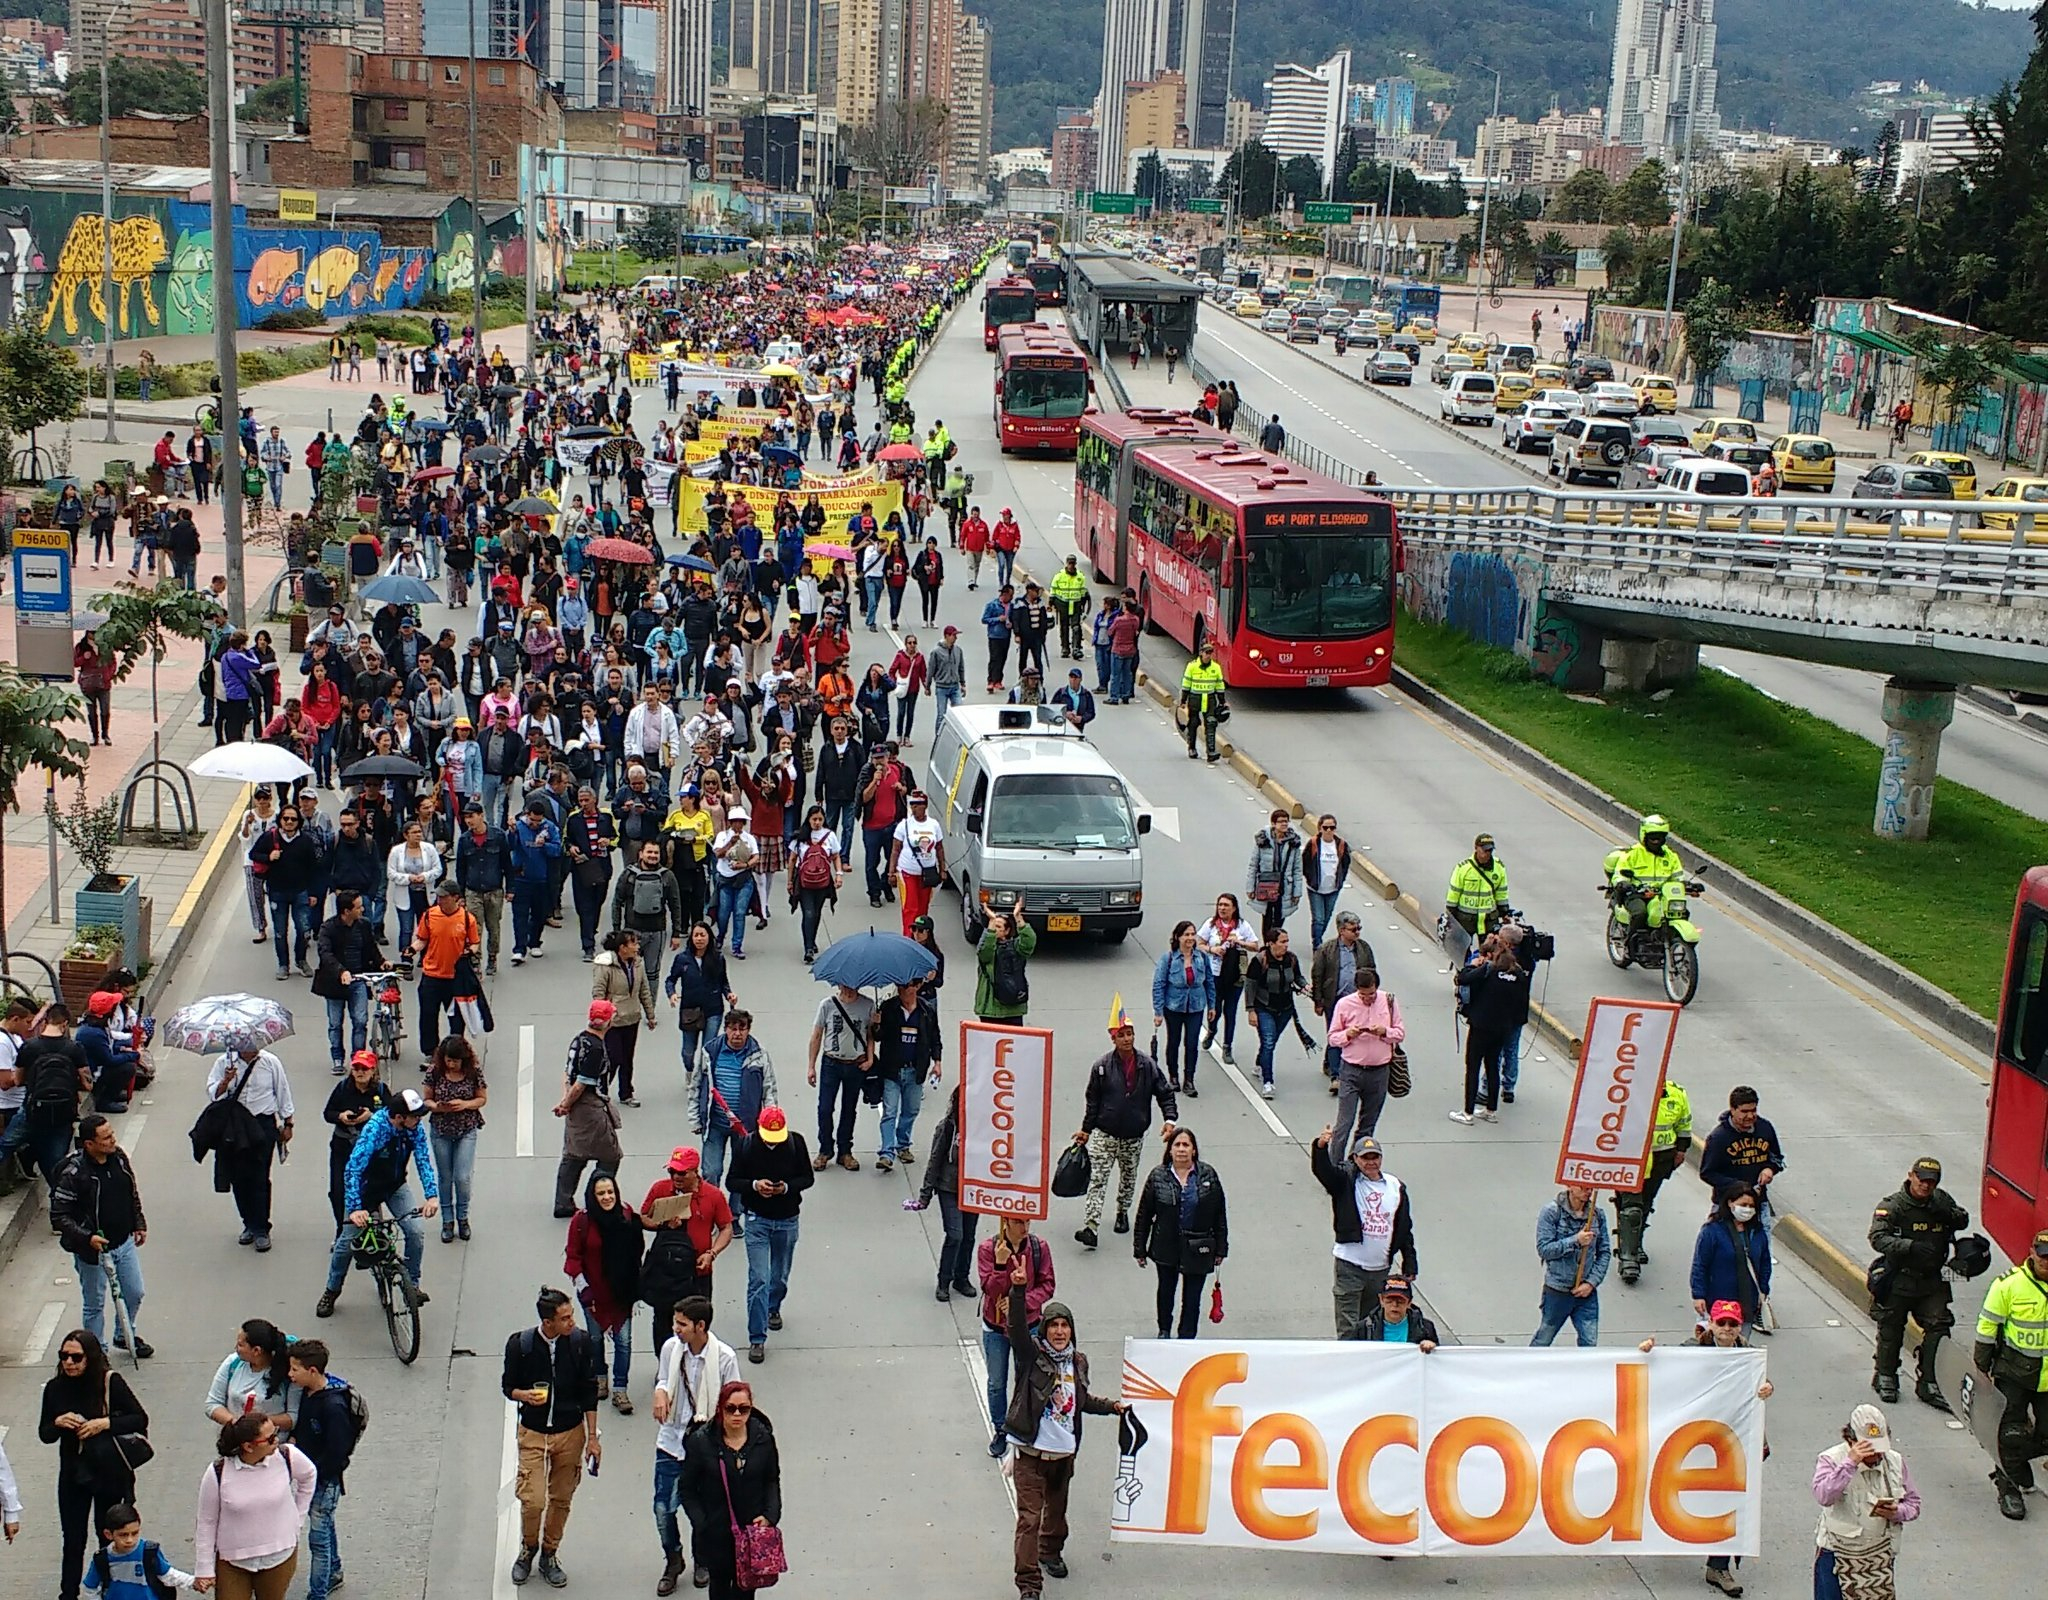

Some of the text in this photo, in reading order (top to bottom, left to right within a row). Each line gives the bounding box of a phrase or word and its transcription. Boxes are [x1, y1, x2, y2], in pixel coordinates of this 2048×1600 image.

[719, 415, 747, 425] PABLO
[803, 475, 875, 489] TOM ADAMS
[1290, 513, 1316, 526] PORT
[19, 533, 62, 546] 796A00
[1595, 1012, 1644, 1152] fecode
[989, 1038, 1015, 1179] fecode
[1726, 1137, 1769, 1157] CHICAGO
[1574, 1162, 1635, 1185] fecode
[974, 1188, 1037, 1213] fecode
[1165, 1352, 1748, 1546] fecode
